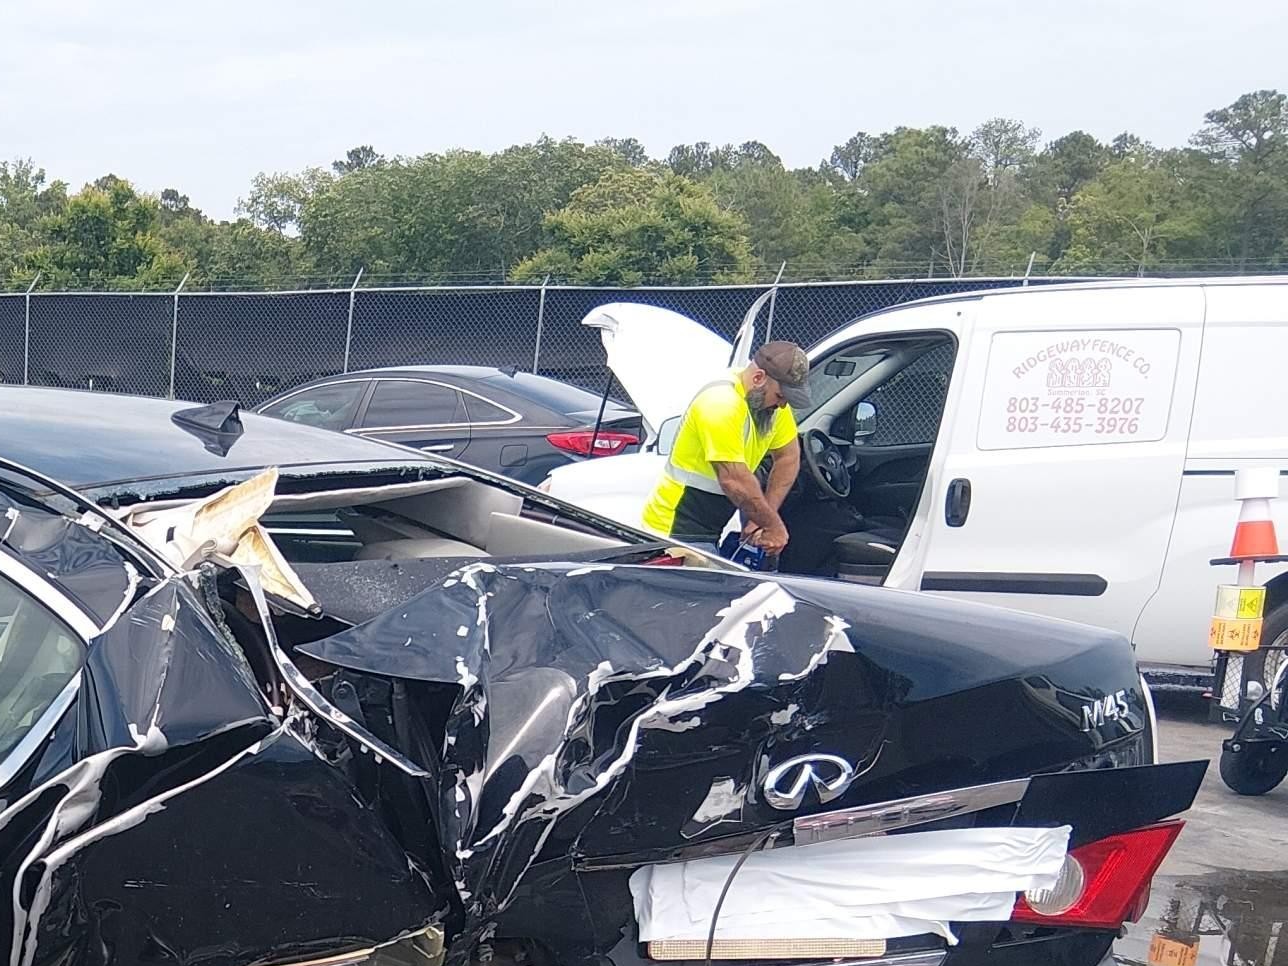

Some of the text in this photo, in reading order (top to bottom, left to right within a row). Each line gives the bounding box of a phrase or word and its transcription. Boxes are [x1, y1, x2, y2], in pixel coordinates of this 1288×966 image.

[1012, 339, 1152, 379] RIDGEWAY FENCE CO.
[1006, 397, 1144, 414] 803-485-8207
[1006, 416, 1139, 434] 803-435-3976
[1079, 690, 1129, 732] M45
